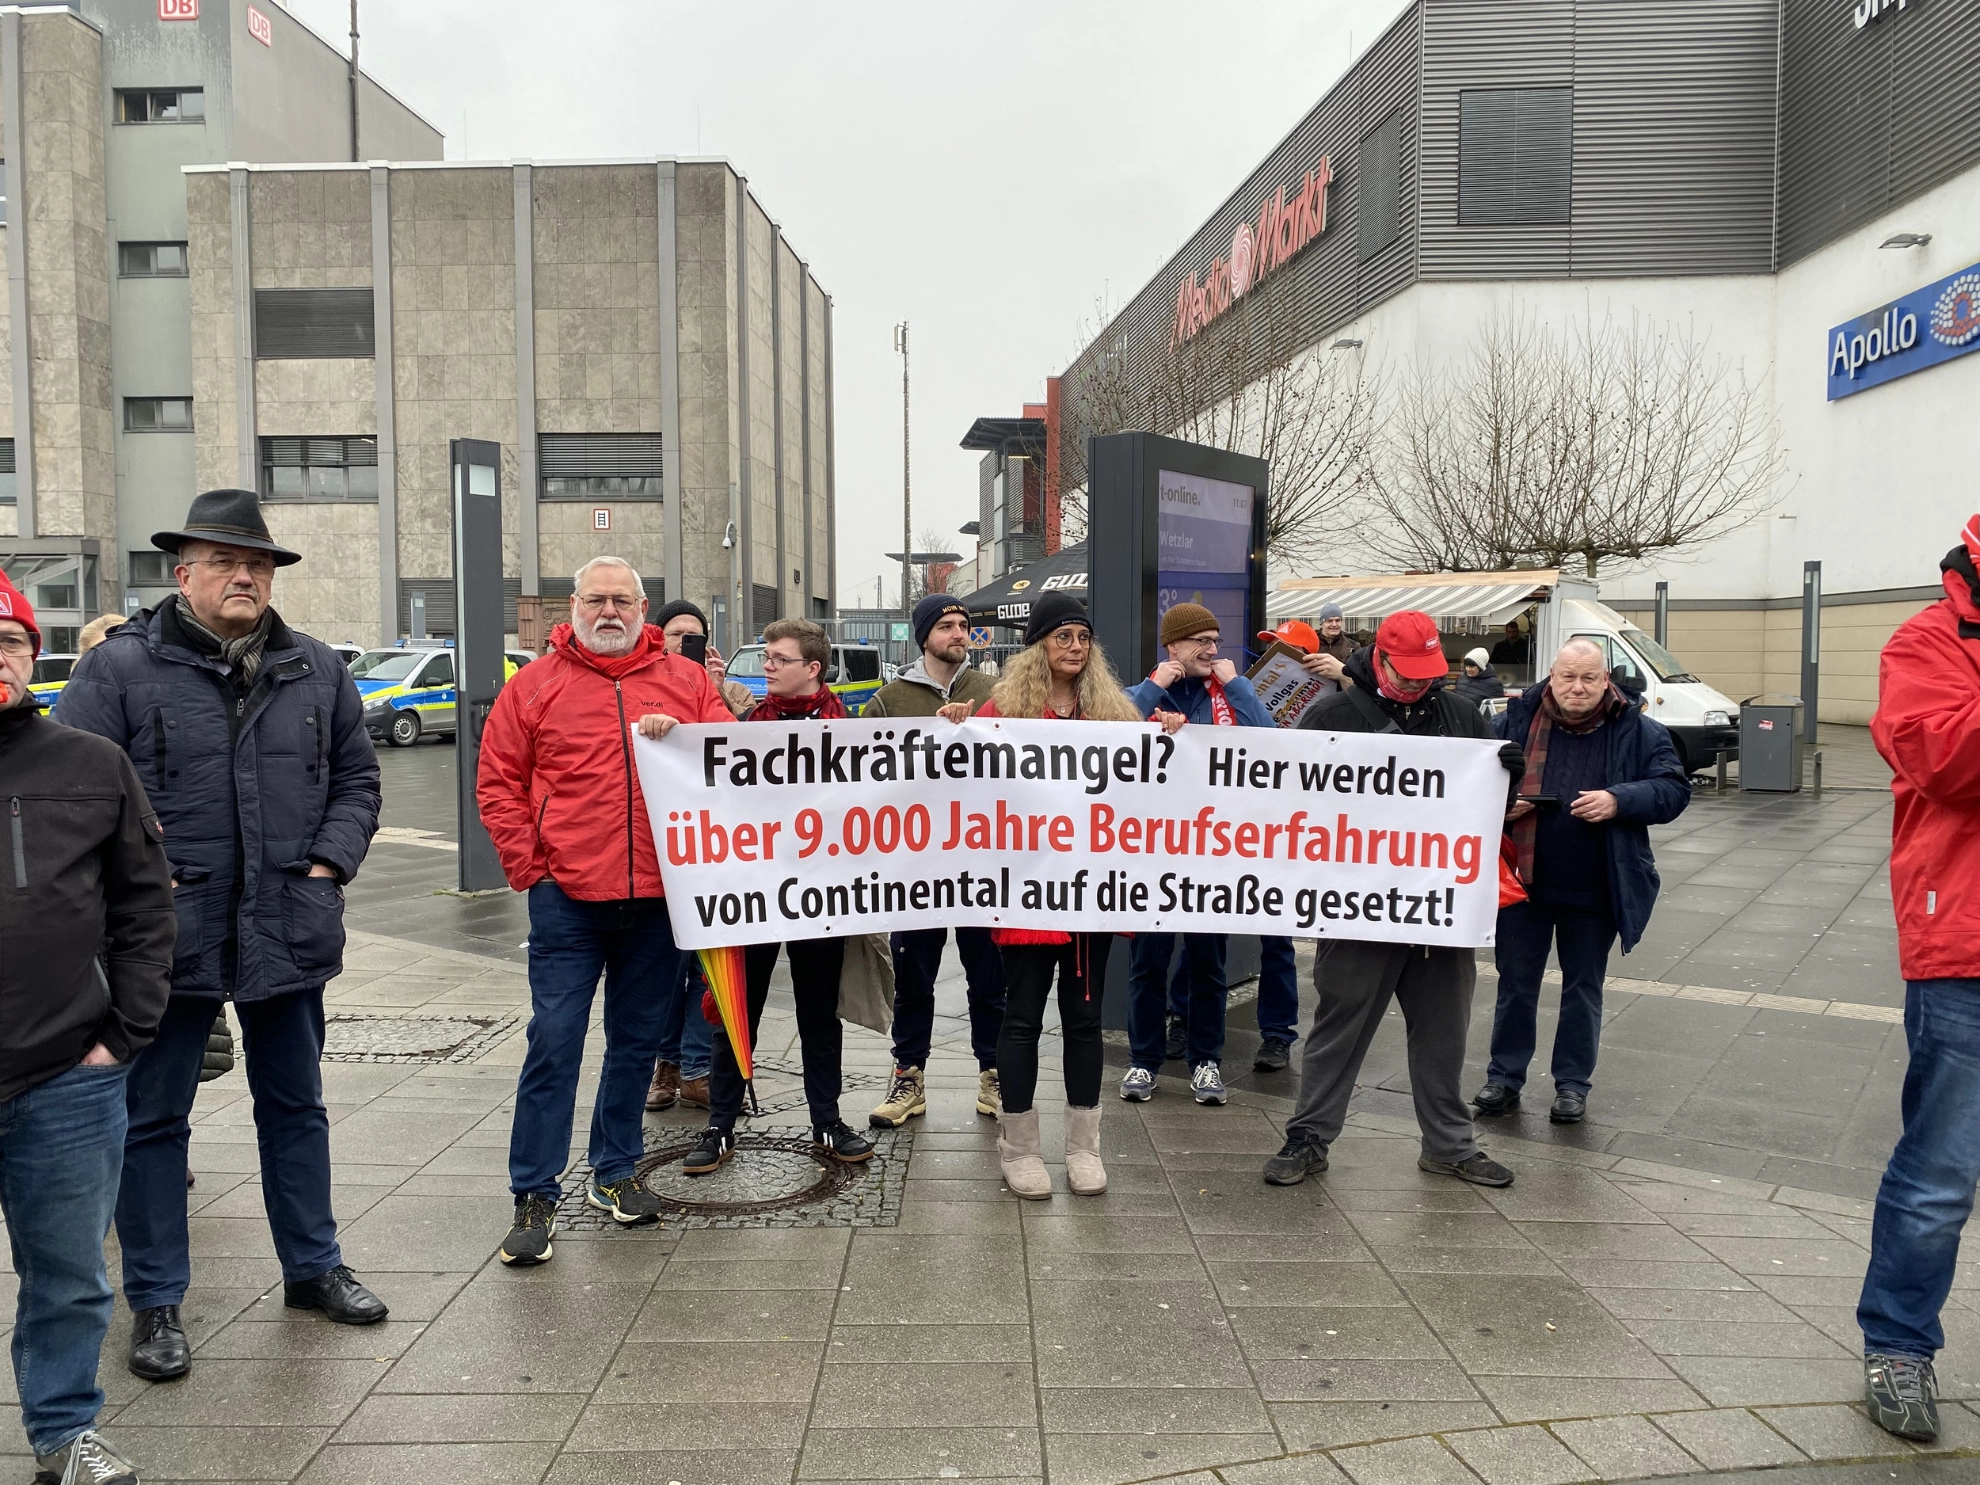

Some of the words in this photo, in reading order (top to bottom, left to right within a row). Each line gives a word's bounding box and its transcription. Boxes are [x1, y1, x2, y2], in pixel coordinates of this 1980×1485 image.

[163, 0, 193, 14] DB
[252, 11, 269, 39] DB
[1830, 307, 1917, 380] Apollo
[1160, 484, 1201, 506] t-online.
[1160, 531, 1193, 549] Wetzlar
[640, 700, 664, 709] ver.di
[1265, 679, 1299, 712] Vollgas
[703, 729, 1176, 794] Fachkräftemangel?
[1208, 747, 1289, 790] Hier
[1299, 755, 1446, 799] werden
[666, 810, 782, 866] über
[794, 803, 931, 859] 9.000
[942, 800, 1075, 852] Jahre
[1089, 803, 1482, 884] Berufserfahrung
[694, 889, 768, 928] von
[778, 867, 1010, 920] Continental
[1021, 869, 1089, 911] auf
[1097, 870, 1148, 912] die
[1158, 872, 1284, 916] Straße
[1295, 886, 1456, 928] gesetzt!
